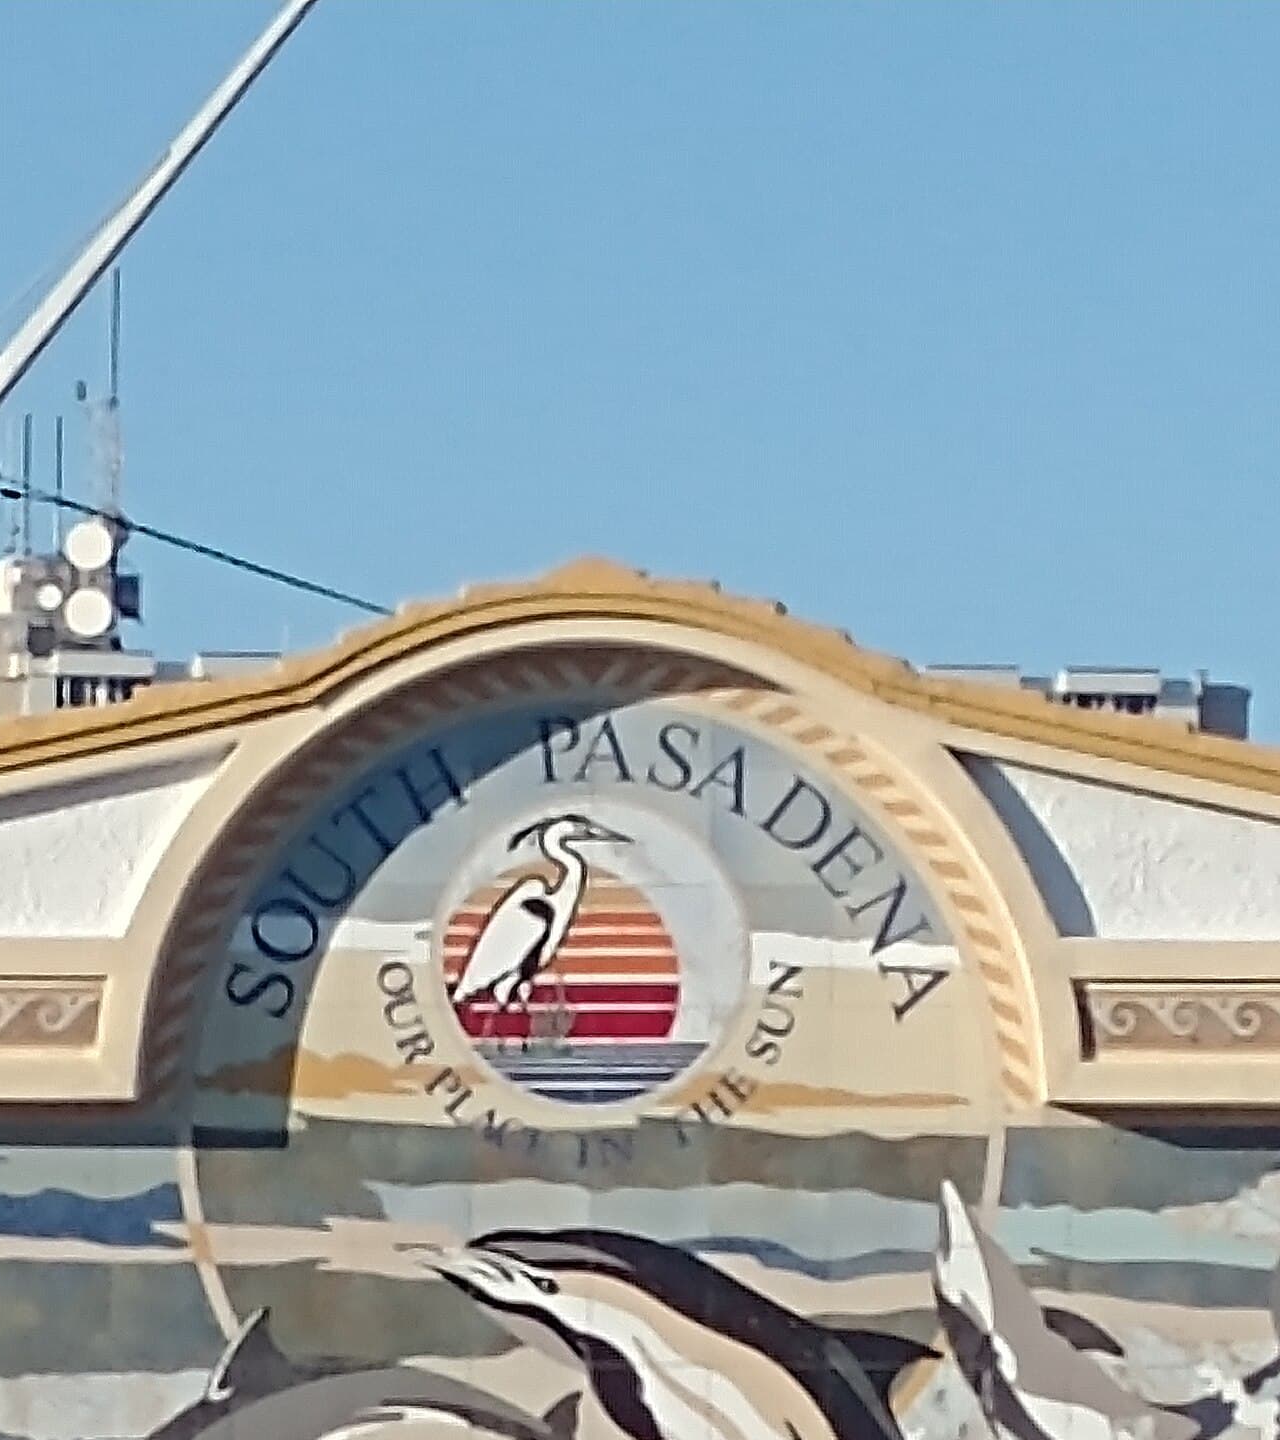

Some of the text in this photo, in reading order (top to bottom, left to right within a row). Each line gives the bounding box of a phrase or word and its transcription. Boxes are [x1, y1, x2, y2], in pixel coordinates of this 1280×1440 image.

[226, 716, 950, 1024] SOUTH PASADENA
[377, 961, 436, 1066] OUR
[745, 959, 804, 1066] SUN
